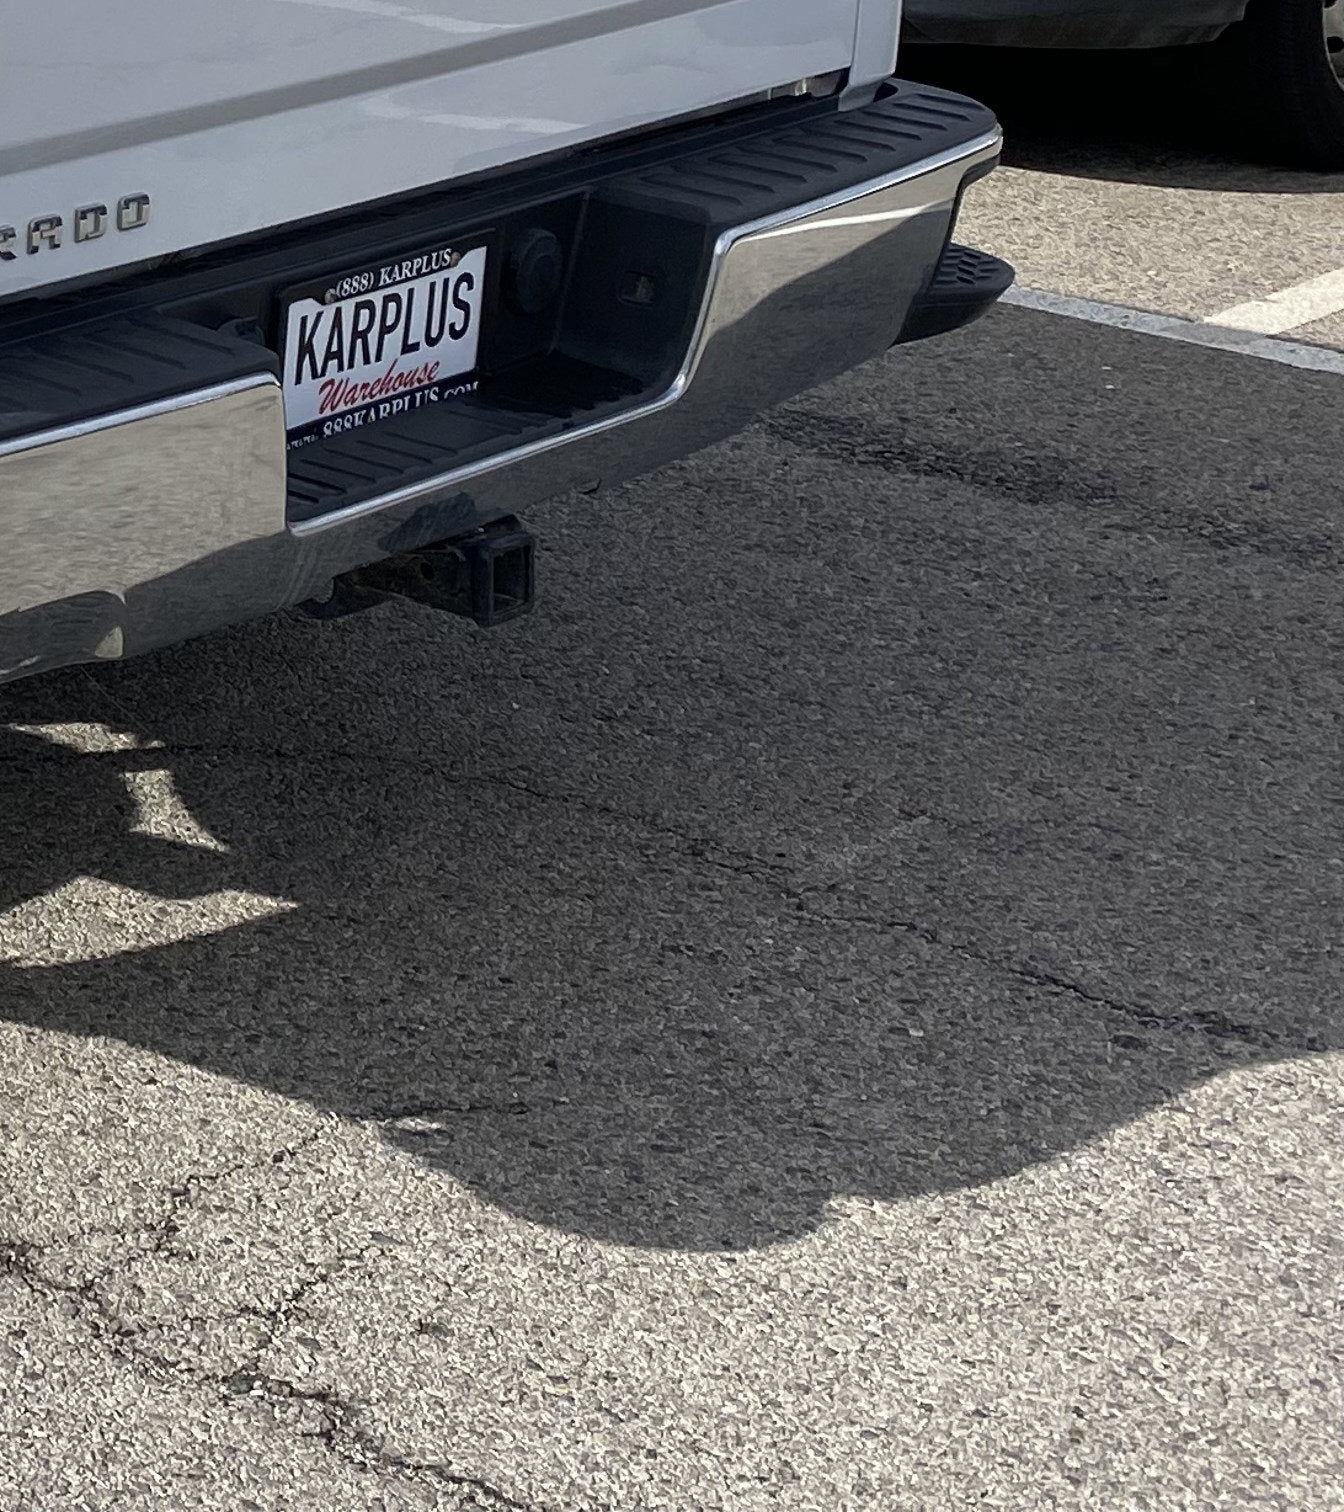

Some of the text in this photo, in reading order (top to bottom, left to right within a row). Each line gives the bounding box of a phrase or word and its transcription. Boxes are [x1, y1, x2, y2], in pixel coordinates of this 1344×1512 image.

[335, 248, 453, 297] (888) KARPLUS
[294, 271, 475, 386] KARPLUS
[318, 358, 441, 415] Warehouse
